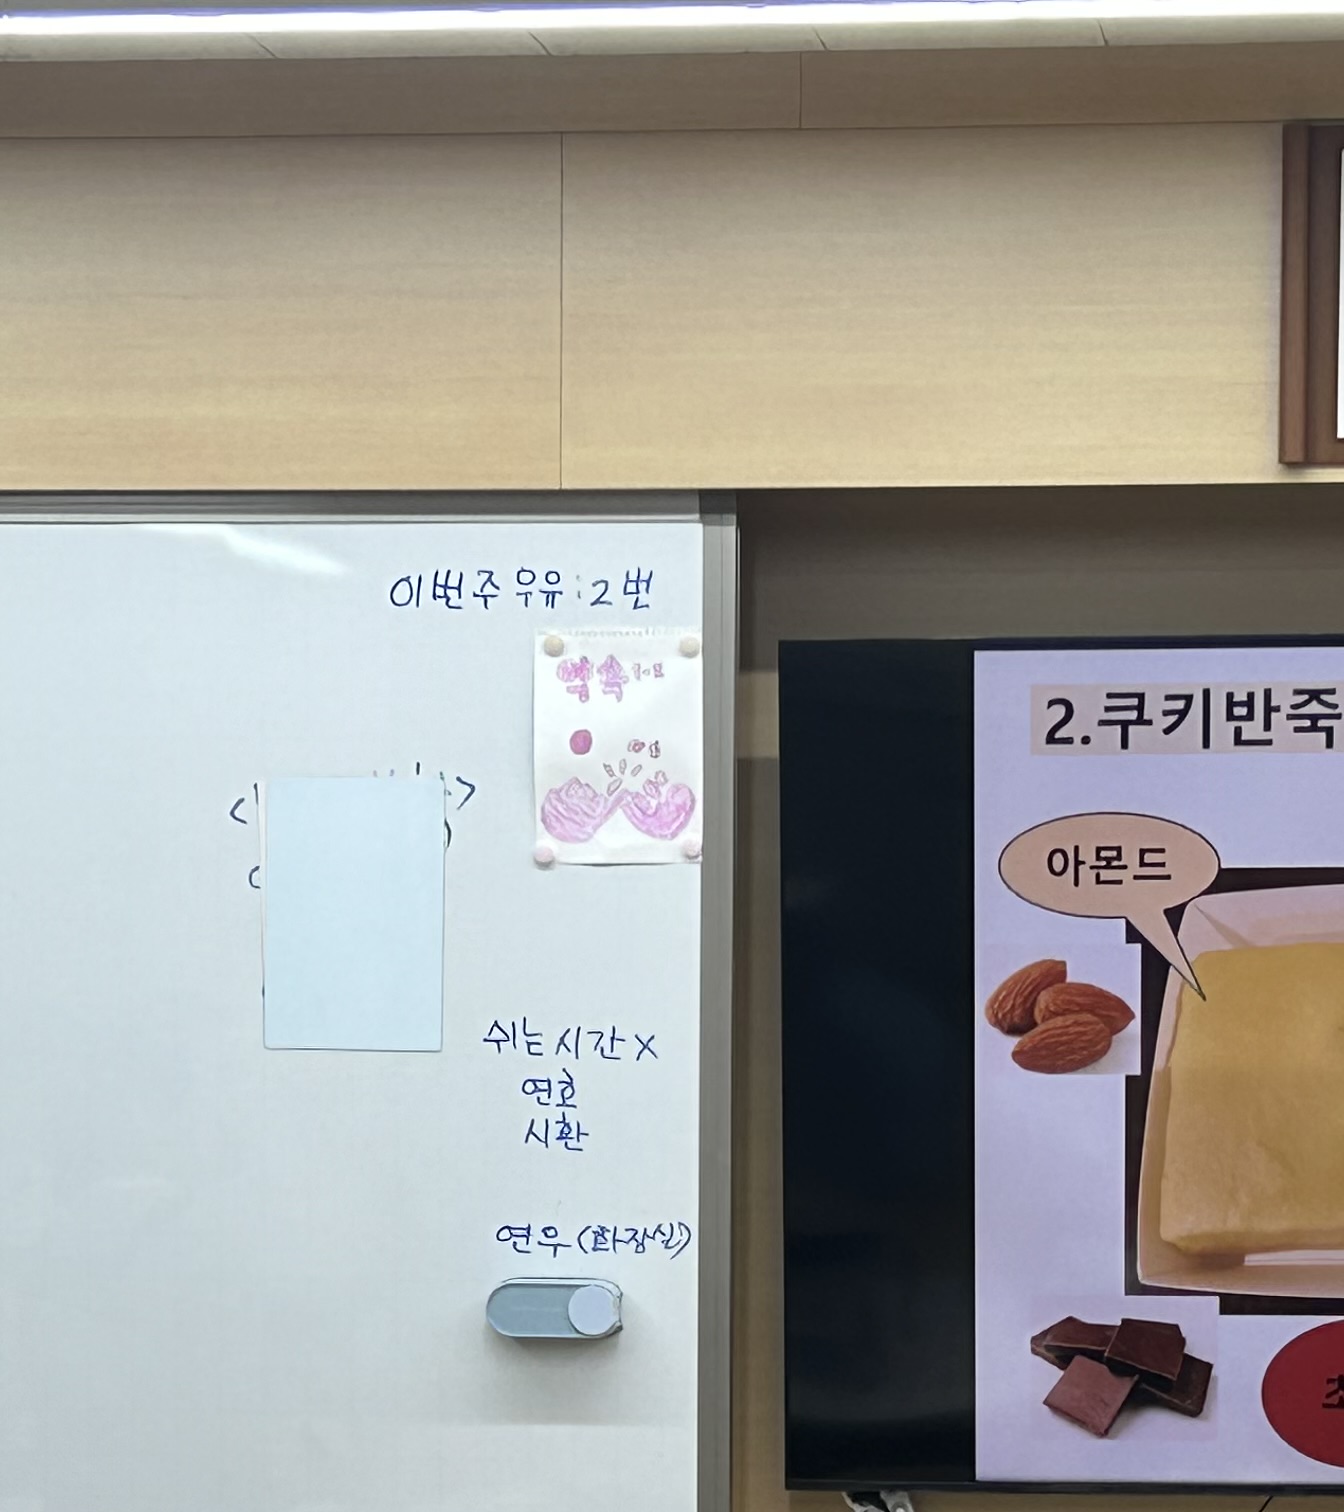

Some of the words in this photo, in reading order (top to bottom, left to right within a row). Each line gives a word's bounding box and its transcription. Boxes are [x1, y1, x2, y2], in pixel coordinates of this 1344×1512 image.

[389, 568, 500, 610] 이번주
[1045, 687, 1343, 750] 2.쿠키반죽
[1047, 845, 1172, 887] 아몬드
[483, 1016, 544, 1056] 쉬는
[555, 1025, 627, 1061] 시간
[521, 1067, 578, 1109] 연호
[524, 1111, 590, 1152] 시환
